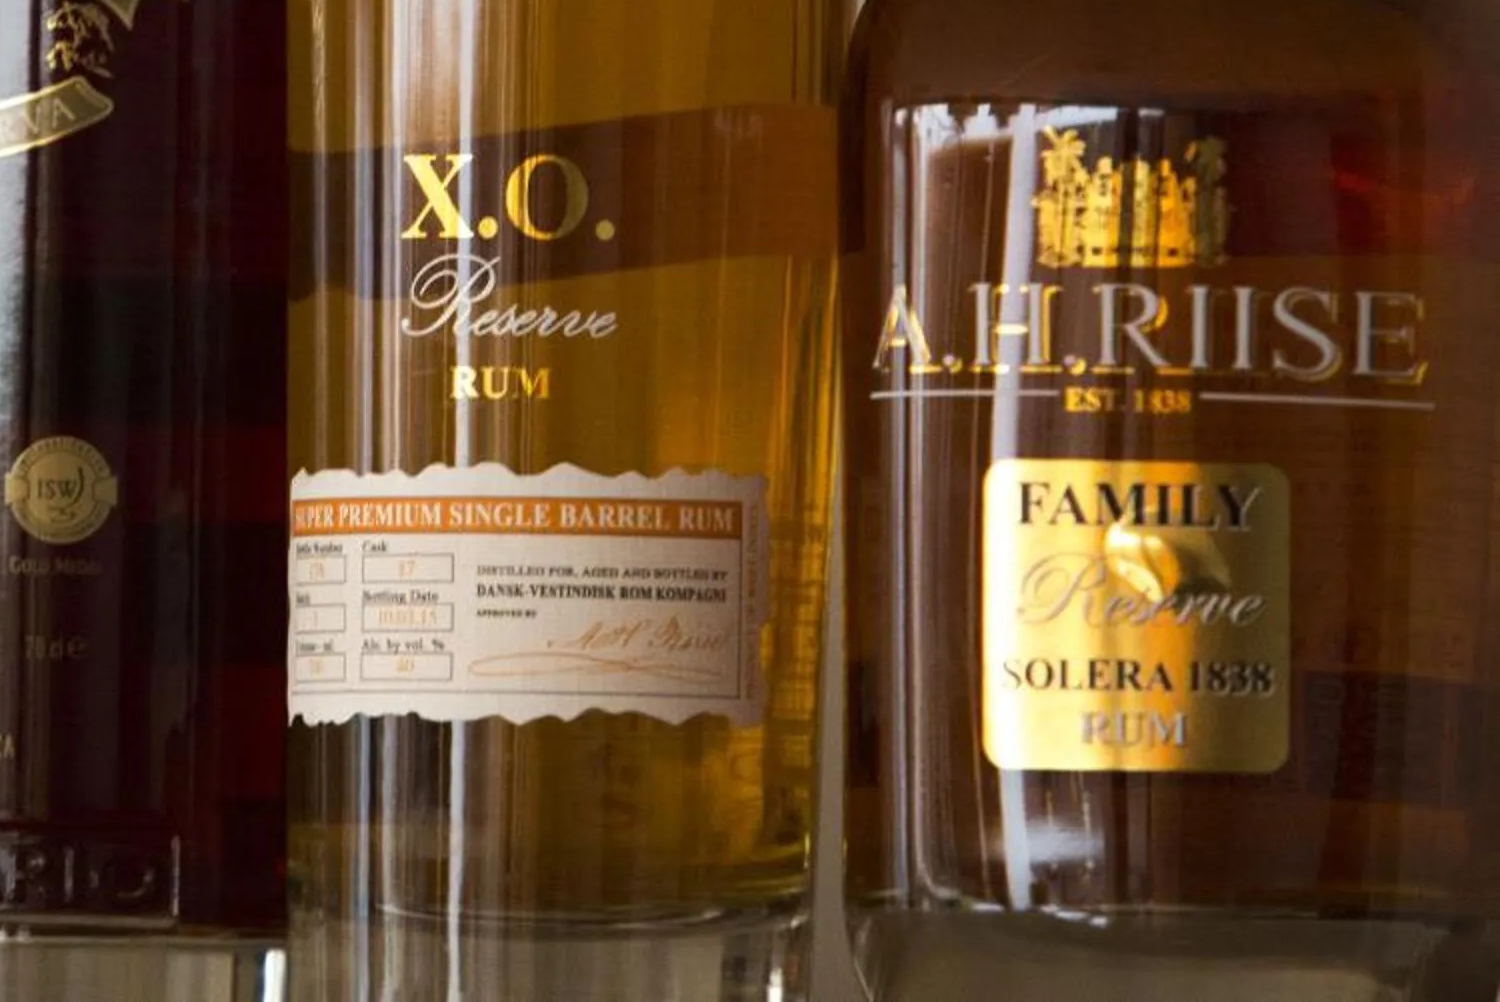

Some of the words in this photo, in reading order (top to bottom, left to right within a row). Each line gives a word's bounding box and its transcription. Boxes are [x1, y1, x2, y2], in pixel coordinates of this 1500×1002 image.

[401, 153, 616, 241] X.O.
[401, 253, 619, 338] Reserve
[873, 281, 1428, 386] A.H.RIISE
[450, 365, 551, 400] RUM
[338, 501, 442, 529] PREMIUM
[448, 502, 552, 528] SINGLE
[560, 504, 670, 531] BARREL
[678, 506, 735, 532] RUM
[1018, 481, 1261, 532] FAMILY
[1016, 553, 1268, 628] Reserve
[1002, 658, 1175, 692] SOLERA
[1188, 660, 1277, 696] 1838
[1081, 710, 1189, 747] RUM
